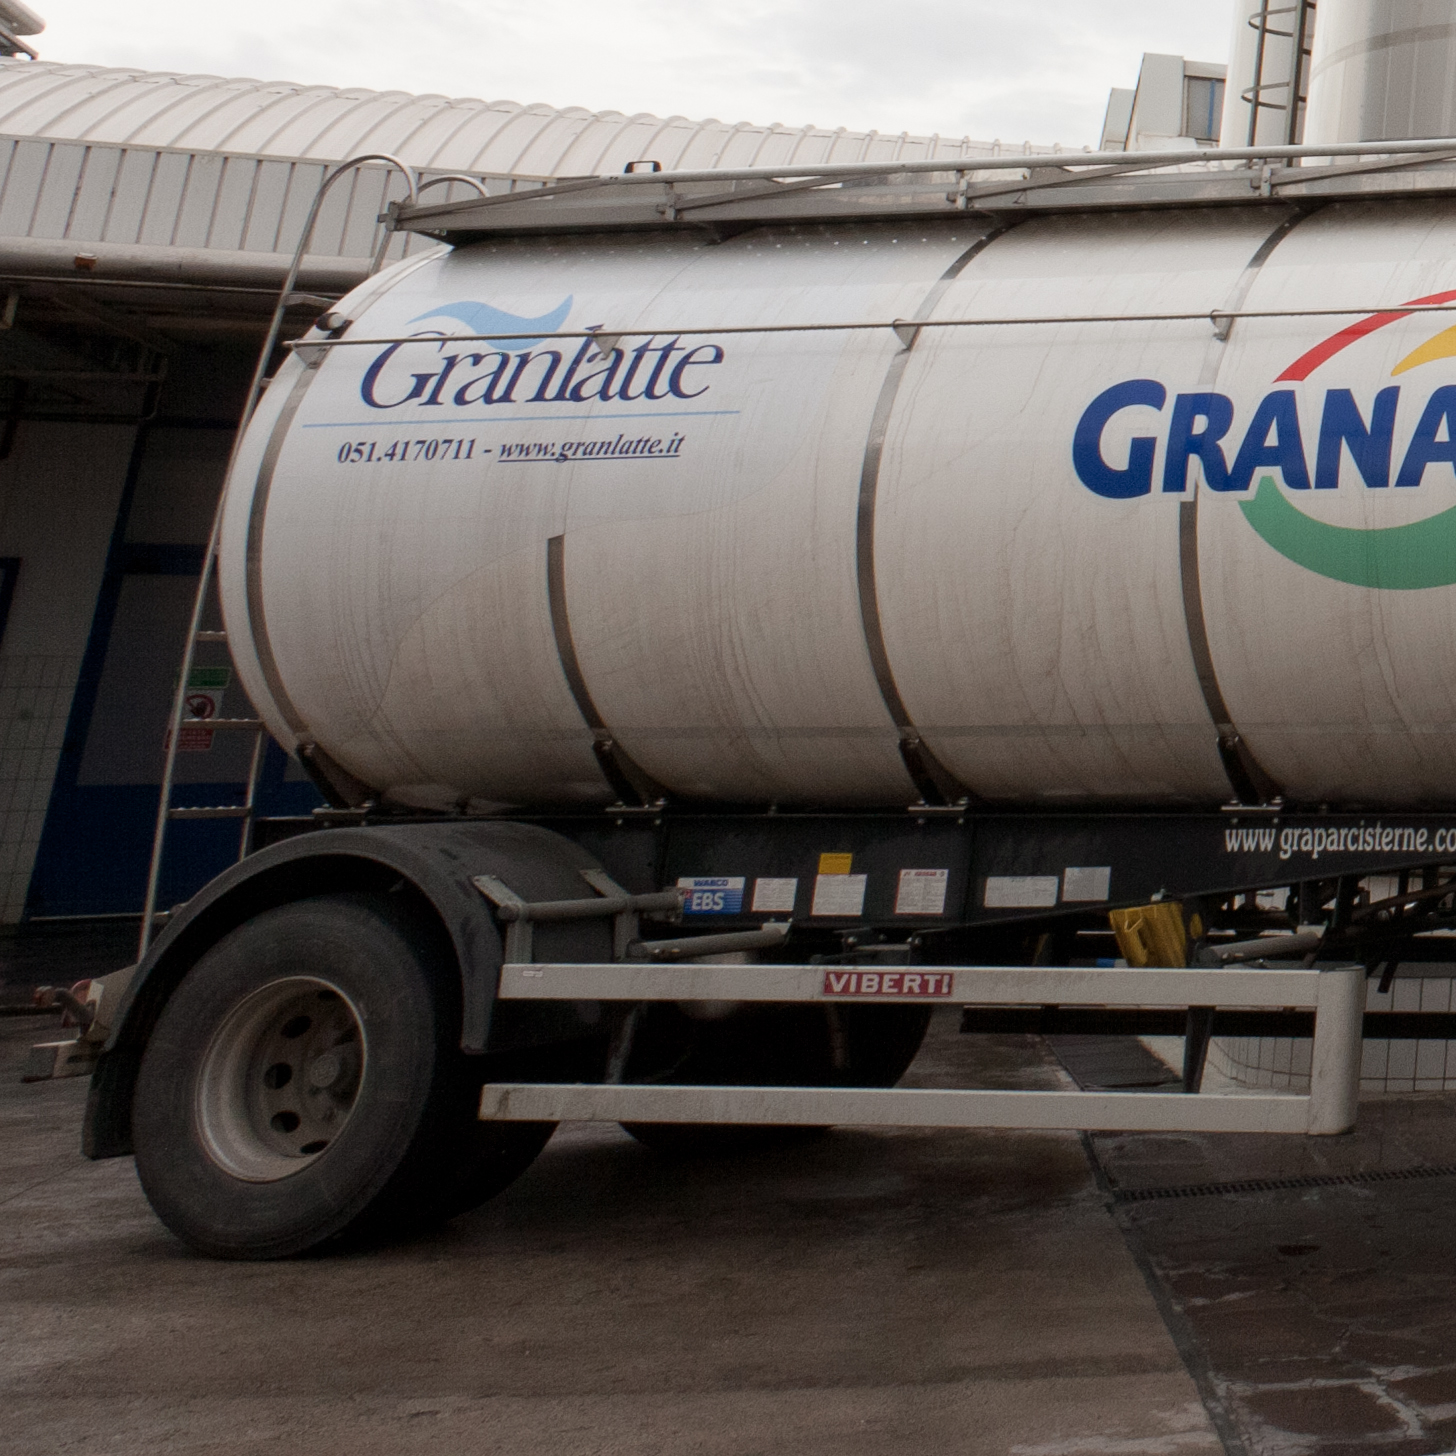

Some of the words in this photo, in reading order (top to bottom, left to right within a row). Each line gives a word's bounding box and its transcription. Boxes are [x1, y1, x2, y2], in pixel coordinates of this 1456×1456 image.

[360, 324, 725, 410] Granlatte
[336, 437, 477, 464] 051.4170711
[498, 432, 686, 464] www.granlatte.it
[691, 891, 725, 911] EBS
[828, 973, 951, 994] VIBERTI
